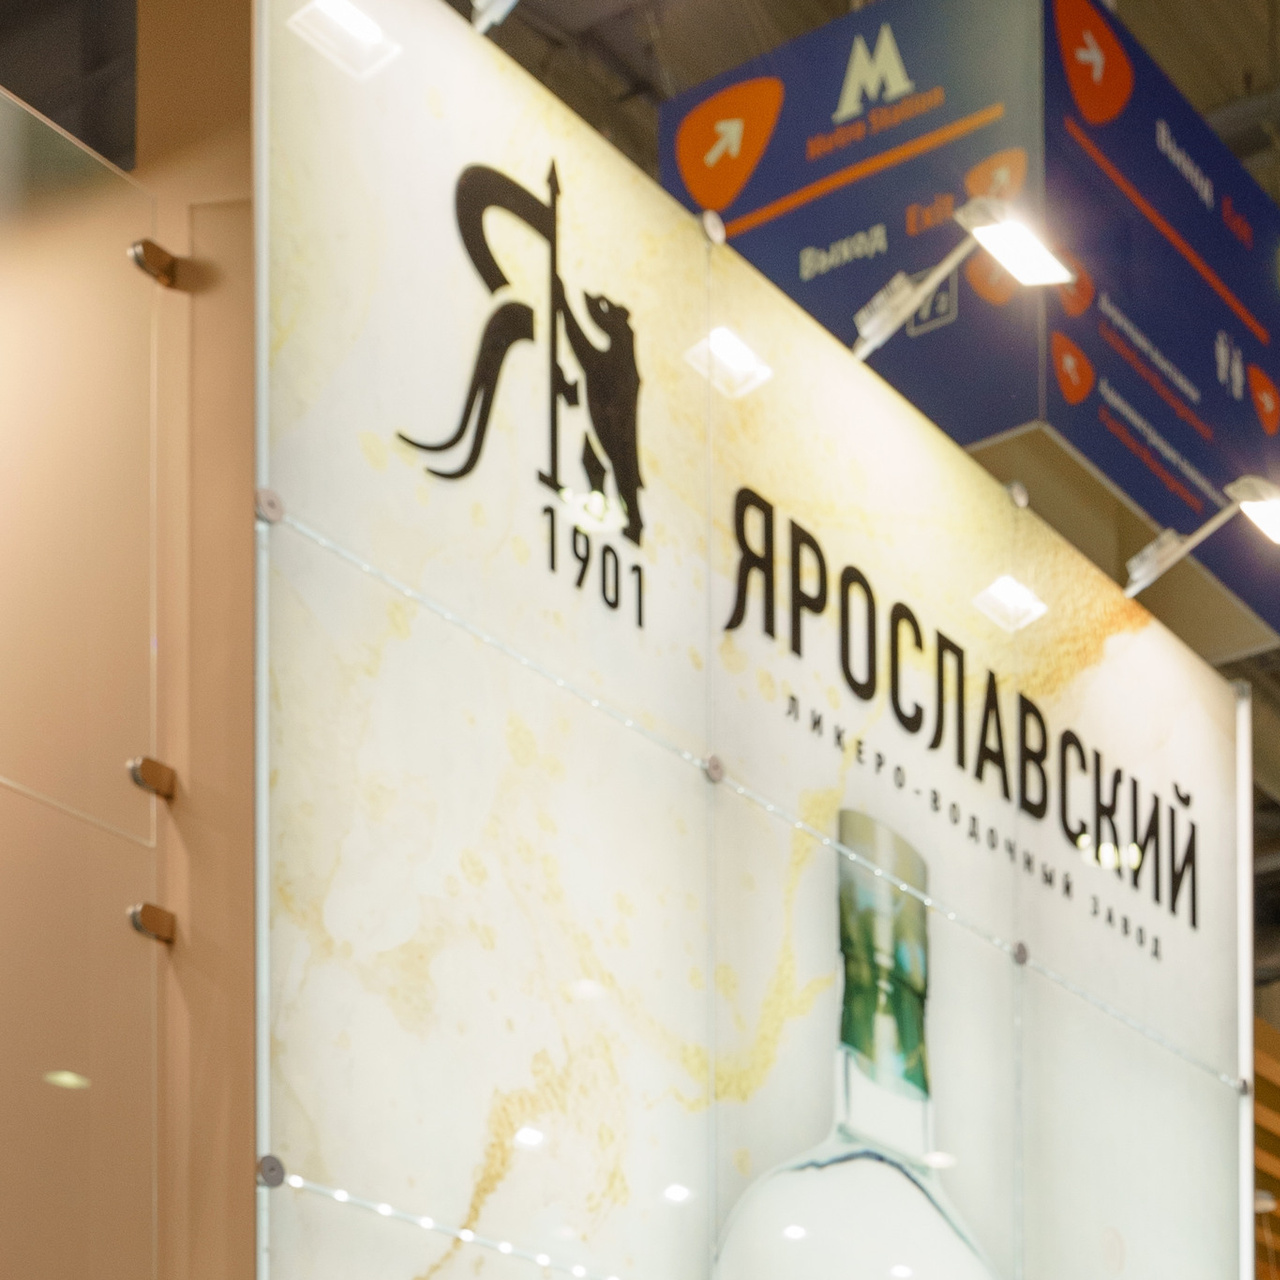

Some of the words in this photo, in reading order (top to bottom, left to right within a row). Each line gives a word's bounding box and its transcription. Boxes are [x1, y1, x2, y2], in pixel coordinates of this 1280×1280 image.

[799, 223, 888, 282] Выход
[544, 506, 645, 629] 1901
[723, 487, 1198, 930] ЯРОСЛАВСКИЙ
[1091, 896, 1162, 961] ЗАВОД
